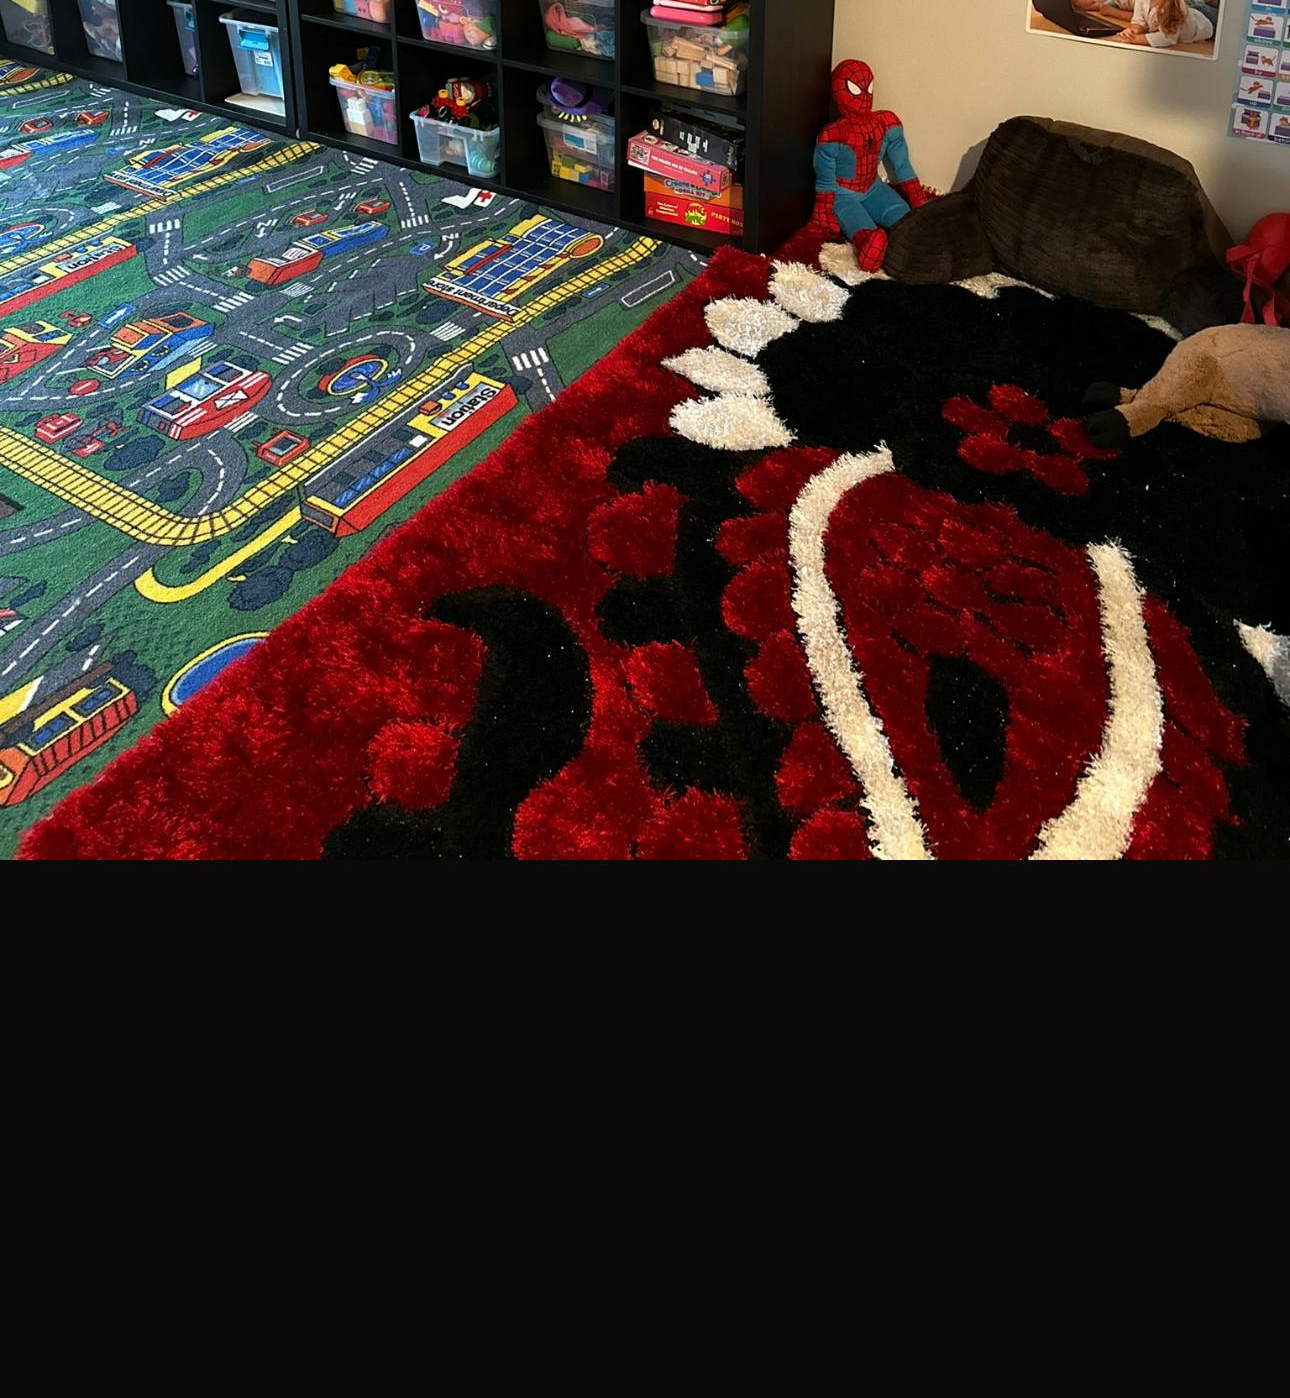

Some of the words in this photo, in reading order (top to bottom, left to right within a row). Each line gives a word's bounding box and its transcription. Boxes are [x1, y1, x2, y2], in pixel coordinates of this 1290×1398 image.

[711, 211, 730, 223] PARTY
[430, 279, 456, 295] store
[457, 288, 519, 318] Department
[441, 387, 498, 426] Station
